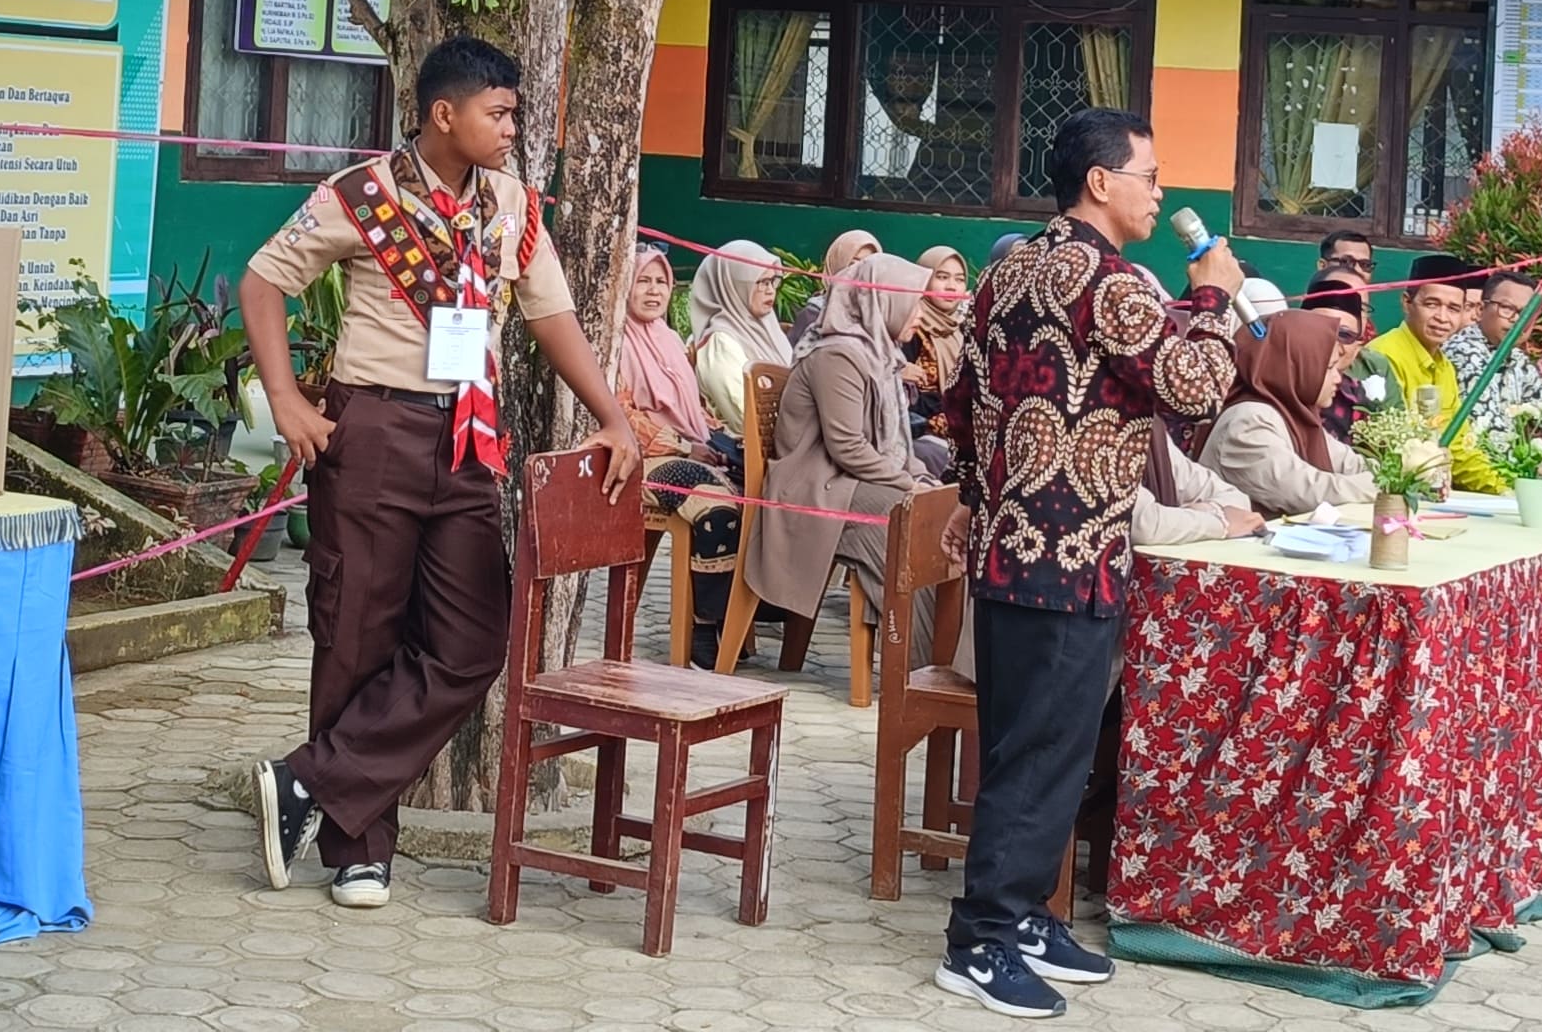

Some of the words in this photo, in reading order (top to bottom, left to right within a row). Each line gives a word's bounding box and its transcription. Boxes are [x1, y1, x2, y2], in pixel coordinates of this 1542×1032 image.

[8, 86, 27, 101] Dan
[28, 87, 71, 105] Bertaqwa
[24, 157, 54, 171] Secara
[56, 158, 78, 172] Utuh
[33, 192, 67, 208] Dengan
[68, 192, 89, 206] Baik
[0, 209, 19, 223] Dan
[21, 210, 39, 223] Asri
[39, 226, 66, 242] Tanpa
[27, 261, 56, 274] Untuk
